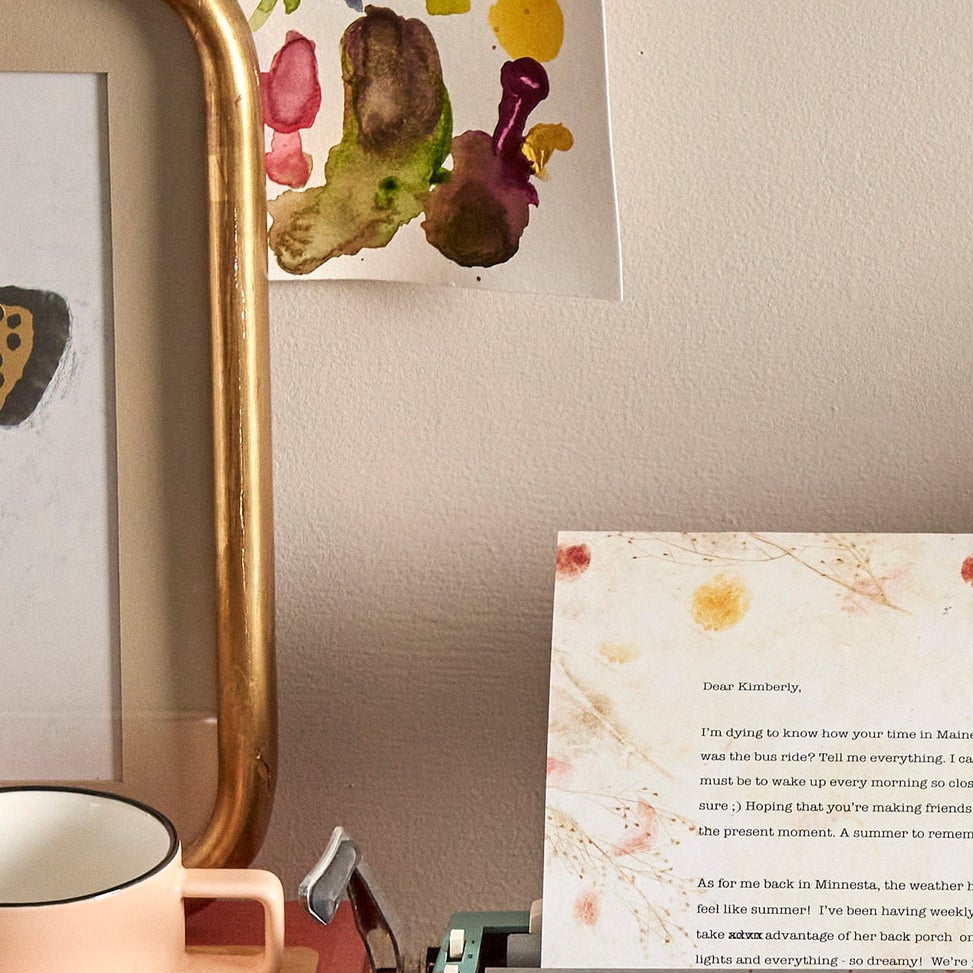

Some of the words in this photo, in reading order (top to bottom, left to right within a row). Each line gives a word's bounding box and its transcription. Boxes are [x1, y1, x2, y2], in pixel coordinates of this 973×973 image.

[702, 681, 734, 692] Dear
[737, 681, 801, 694] Kimberly,
[700, 727, 722, 738] I'm
[725, 727, 763, 740] dying
[766, 728, 779, 738] to
[782, 727, 818, 739] know
[821, 728, 849, 739] how
[851, 730, 883, 741] your
[886, 729, 916, 740] time
[919, 729, 932, 740] in
[699, 753, 725, 763] was
[729, 751, 750, 762] the
[753, 751, 777, 762] bus
[780, 751, 815, 763] ride?
[818, 752, 843, 763] Tell
[846, 754, 866, 763] me
[869, 752, 945, 766] everything.
[949, 753, 956, 764] I
[698, 802, 728, 811] sure
[744, 800, 793, 814] Hoping
[796, 801, 824, 813] that
[825, 801, 869, 815] you're
[871, 802, 922, 816] making
[925, 802, 972, 814] friends
[698, 825, 720, 837] the
[722, 826, 774, 839] present
[777, 827, 835, 838] moment.
[839, 827, 850, 838] A
[852, 829, 908, 839] summer
[911, 828, 924, 840] to
[696, 877, 714, 889] As
[717, 877, 737, 889] for
[739, 880, 760, 889] me
[763, 878, 794, 890] back
[797, 879, 811, 890] in
[814, 878, 880, 893] Minnesta,
[884, 879, 905, 891] the
[908, 880, 964, 892] weather
[696, 903, 719, 915] feel
[723, 903, 747, 915] like
[750, 904, 810, 916] summer!
[818, 904, 843, 916] I've
[846, 905, 878, 917] been
[880, 905, 927, 919] having
[695, 954, 732, 967] lights
[735, 954, 760, 966] and
[764, 955, 838, 968] everything
[847, 957, 863, 966] so
[866, 955, 923, 968] dreamy!
[930, 956, 968, 968] We're
